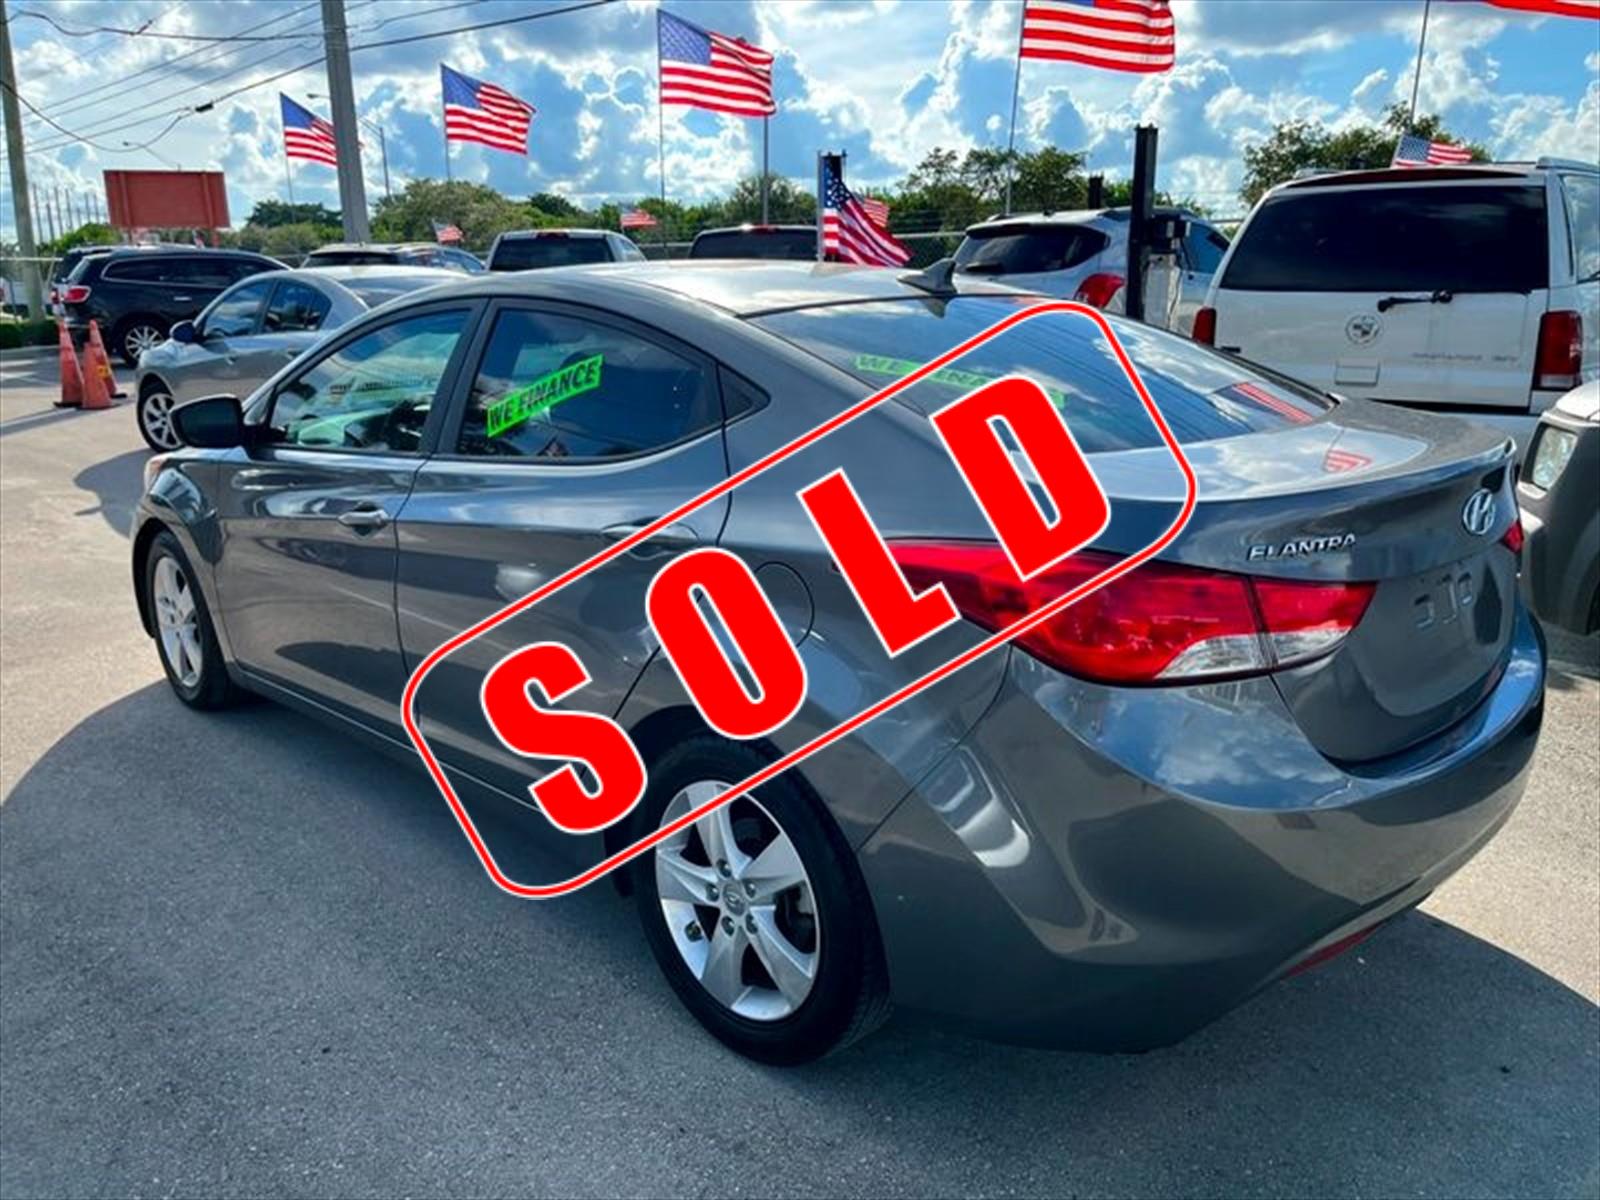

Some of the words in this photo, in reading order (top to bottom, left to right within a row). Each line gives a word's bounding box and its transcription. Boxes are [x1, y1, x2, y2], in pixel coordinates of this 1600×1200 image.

[490, 400, 514, 431] WE
[519, 359, 598, 416] FINANCE
[1248, 532, 1356, 560] ELANTRA
